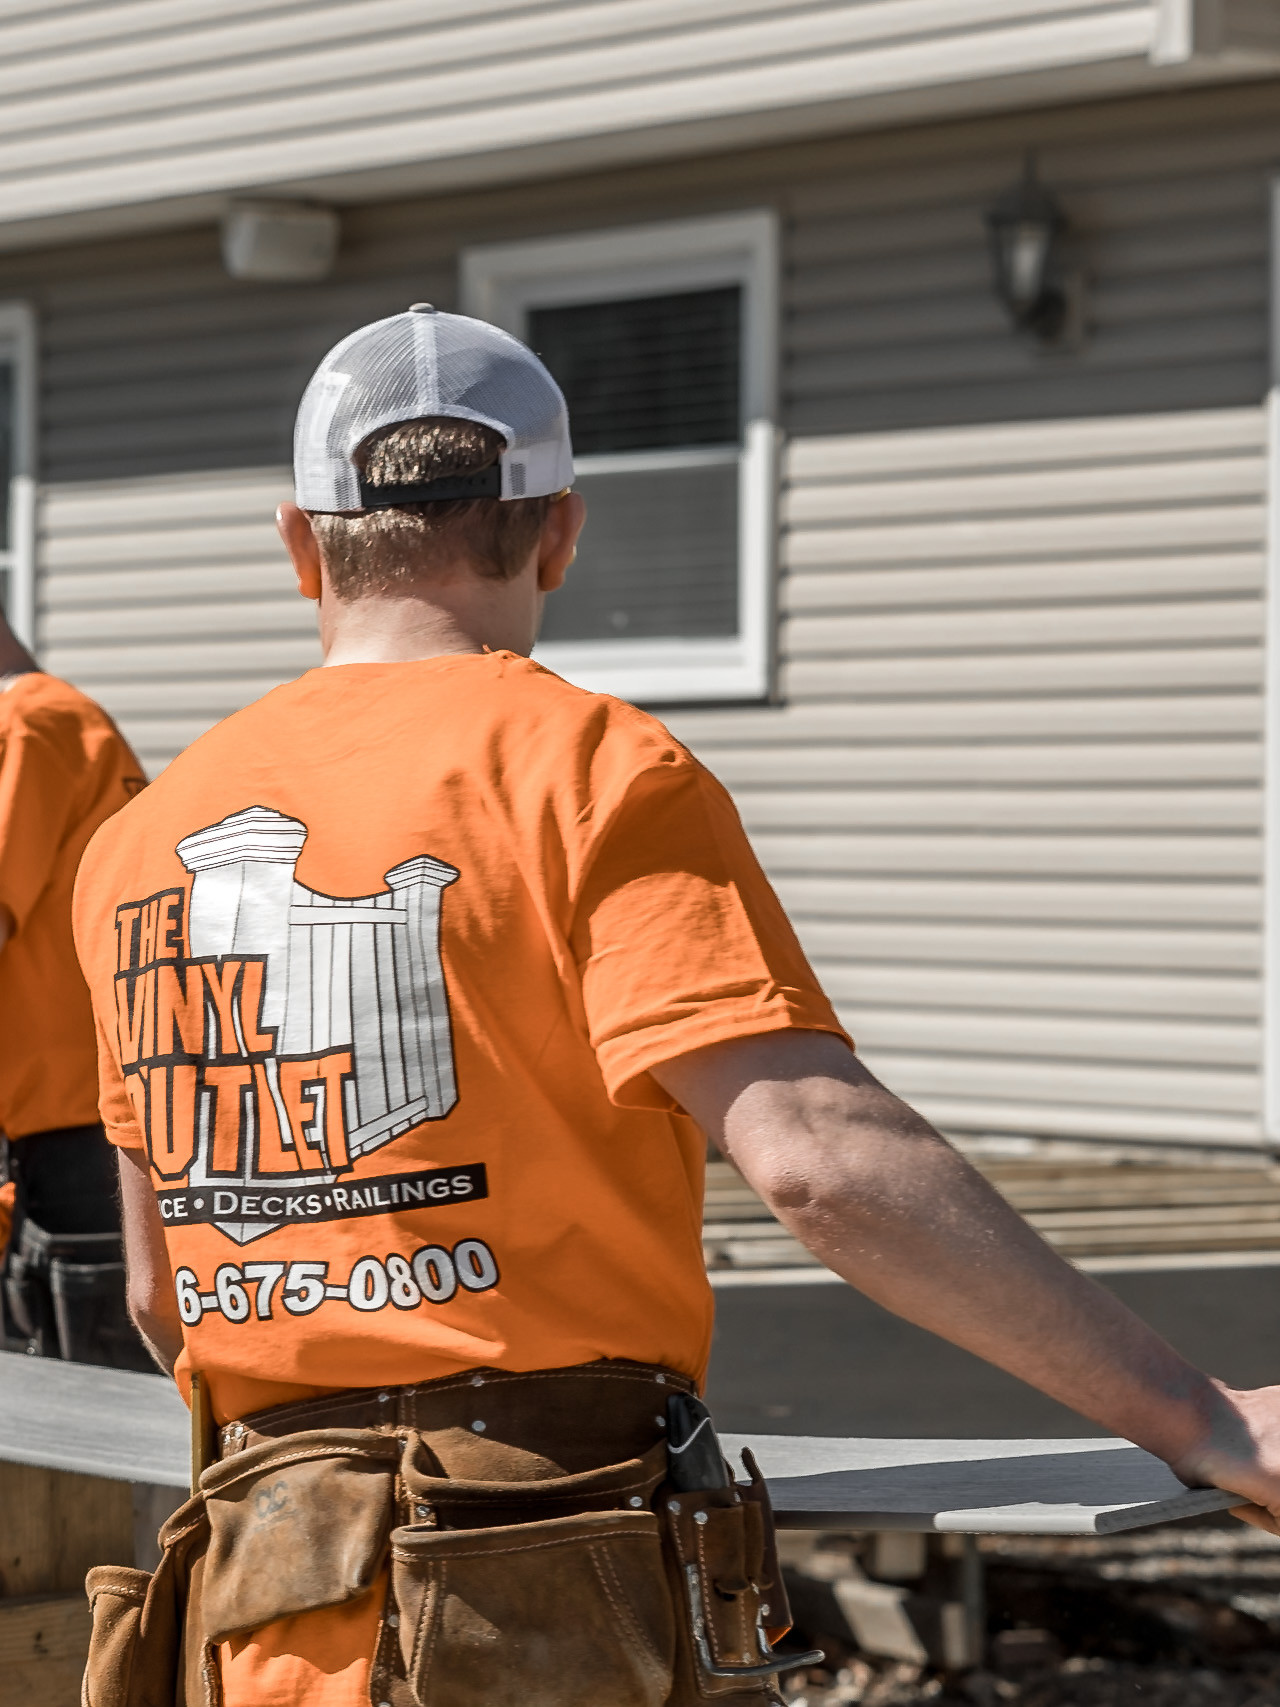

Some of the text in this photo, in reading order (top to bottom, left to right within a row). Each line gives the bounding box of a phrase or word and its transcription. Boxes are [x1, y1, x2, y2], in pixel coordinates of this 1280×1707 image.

[115, 888, 184, 973] THE
[115, 957, 276, 1068] VINYL
[157, 1197, 189, 1219] CE
[175, 1238, 500, 1327] 6-675-0800
